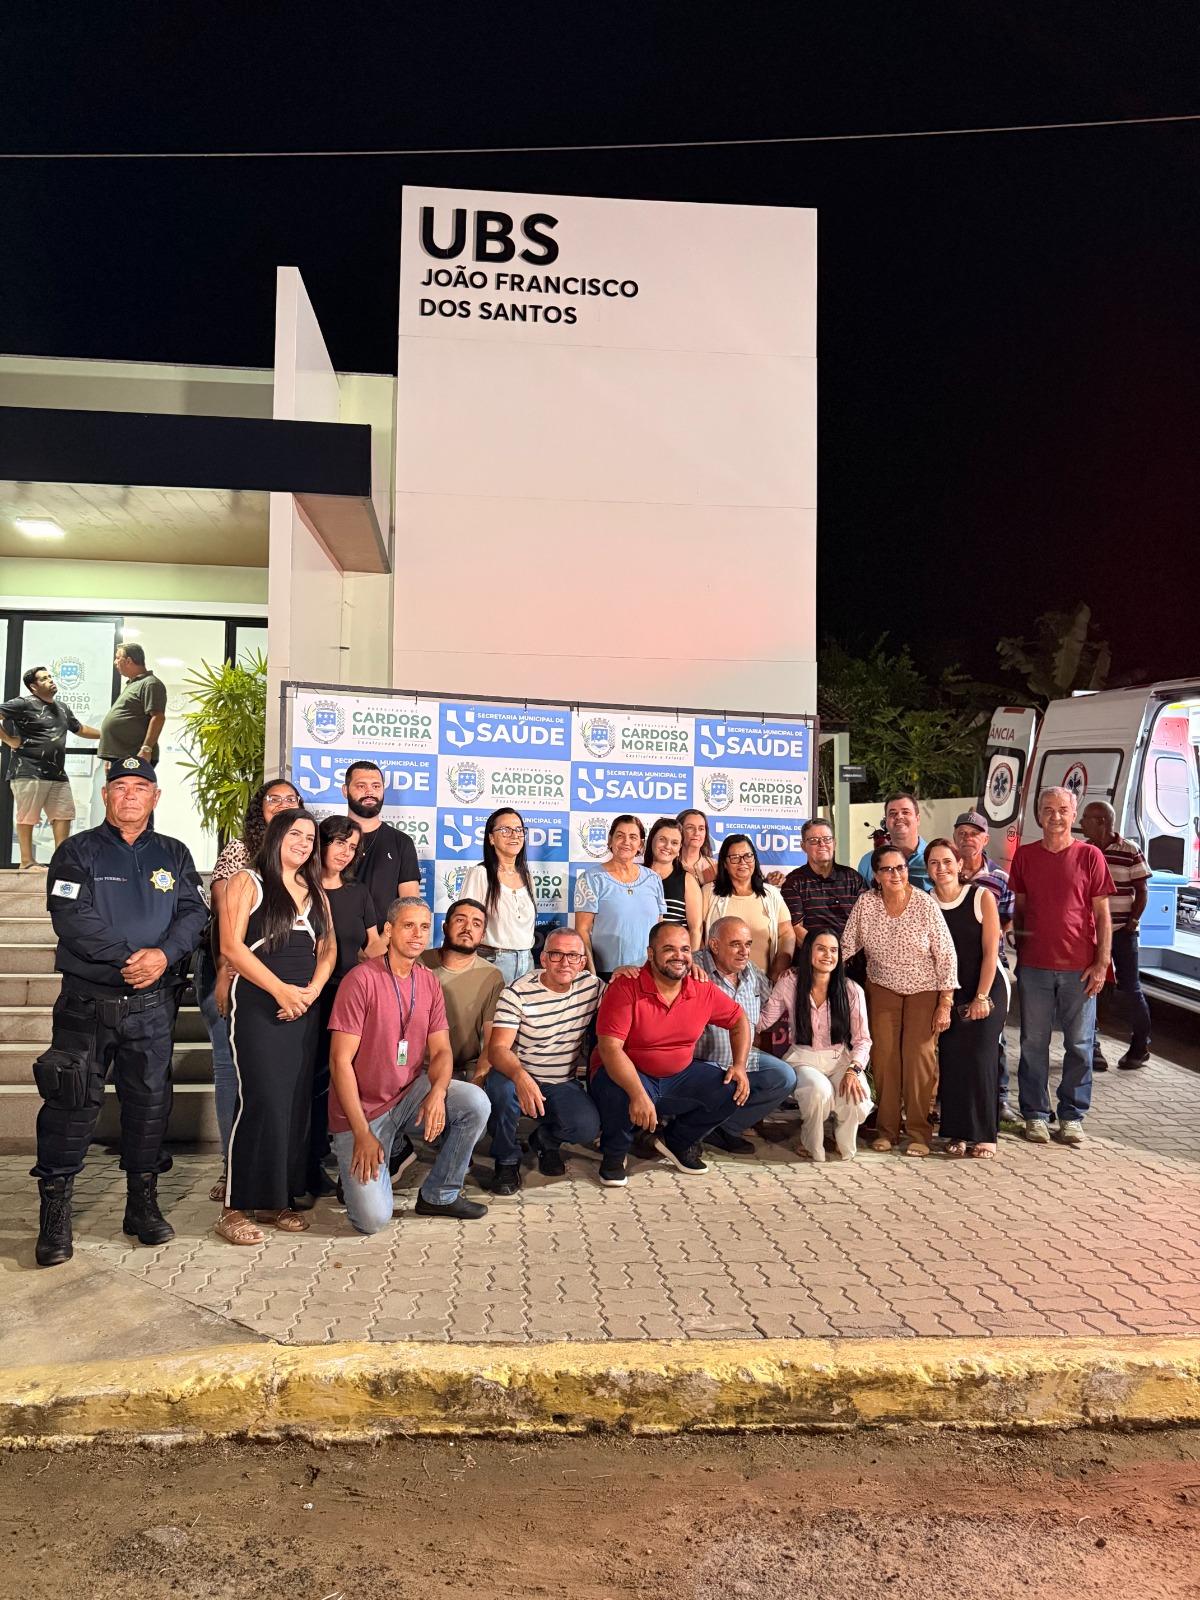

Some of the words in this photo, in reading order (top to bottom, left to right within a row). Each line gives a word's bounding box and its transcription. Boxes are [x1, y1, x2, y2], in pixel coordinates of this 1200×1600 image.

[419, 206, 559, 266] UBS
[421, 265, 488, 290] JOÃO
[495, 273, 639, 298] FRANCISCO
[420, 298, 471, 318] DOS
[479, 302, 578, 325] SANTOS
[352, 711, 432, 727] CARDOSO
[518, 715, 554, 723] MUNICIPAL
[352, 724, 432, 740] MOREIRA
[476, 720, 565, 746] SAÚDE
[621, 727, 689, 741] CARDOSO
[621, 739, 689, 753] MOREIRA
[726, 734, 803, 758] SAÚDE
[380, 759, 418, 767] MUNICIPAL
[491, 771, 564, 785] CARDOSO
[491, 783, 564, 797] MOREIRA
[606, 776, 687, 800] SAÚDE
[739, 781, 803, 794] CARDOSO
[739, 793, 803, 806] MOREIRA
